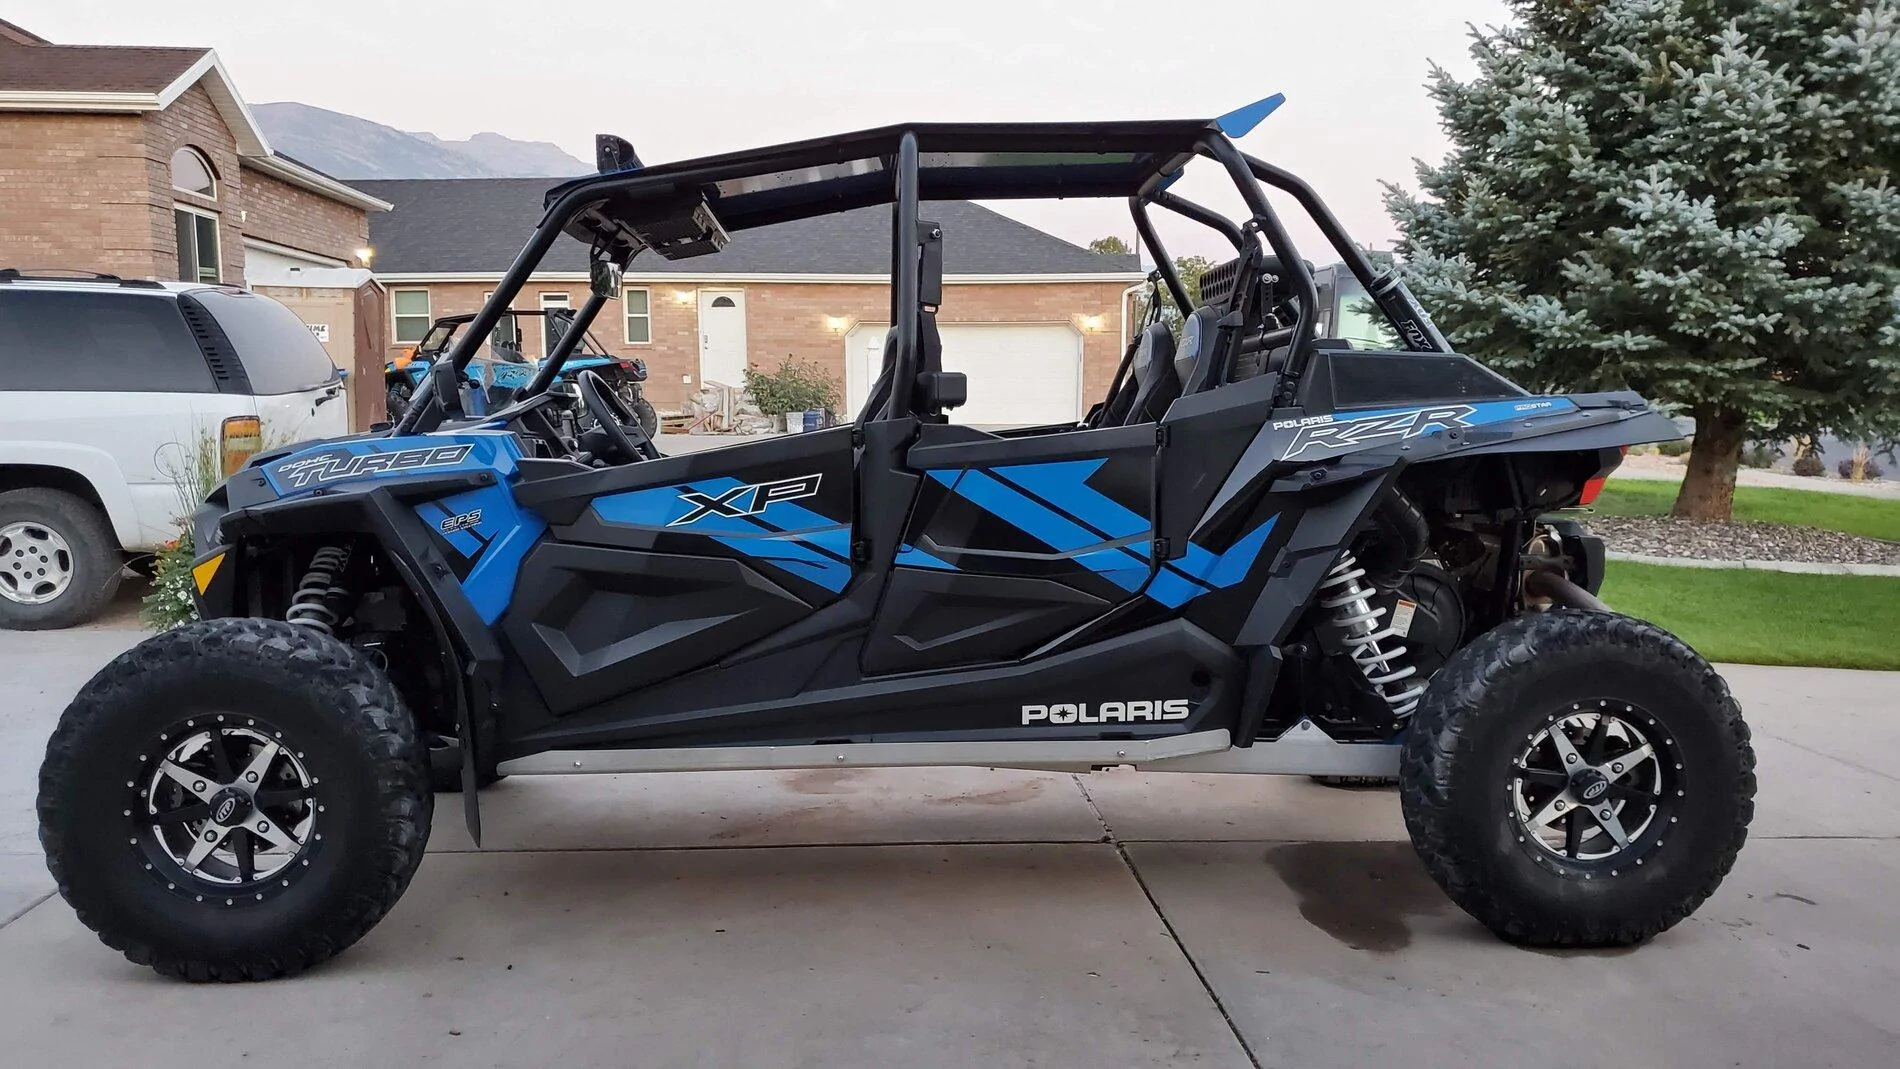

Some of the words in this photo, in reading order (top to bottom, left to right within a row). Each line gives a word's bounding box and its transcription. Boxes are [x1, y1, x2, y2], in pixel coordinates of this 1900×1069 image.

[1400, 319, 1433, 349] FOX
[1273, 414, 1334, 430] POLARIS
[1280, 404, 1479, 462] RZR
[278, 454, 334, 473] DOHC
[288, 443, 476, 488] TURBO
[665, 473, 823, 528] XP
[440, 509, 482, 530] EPS
[1021, 699, 1190, 725] POLARIS
